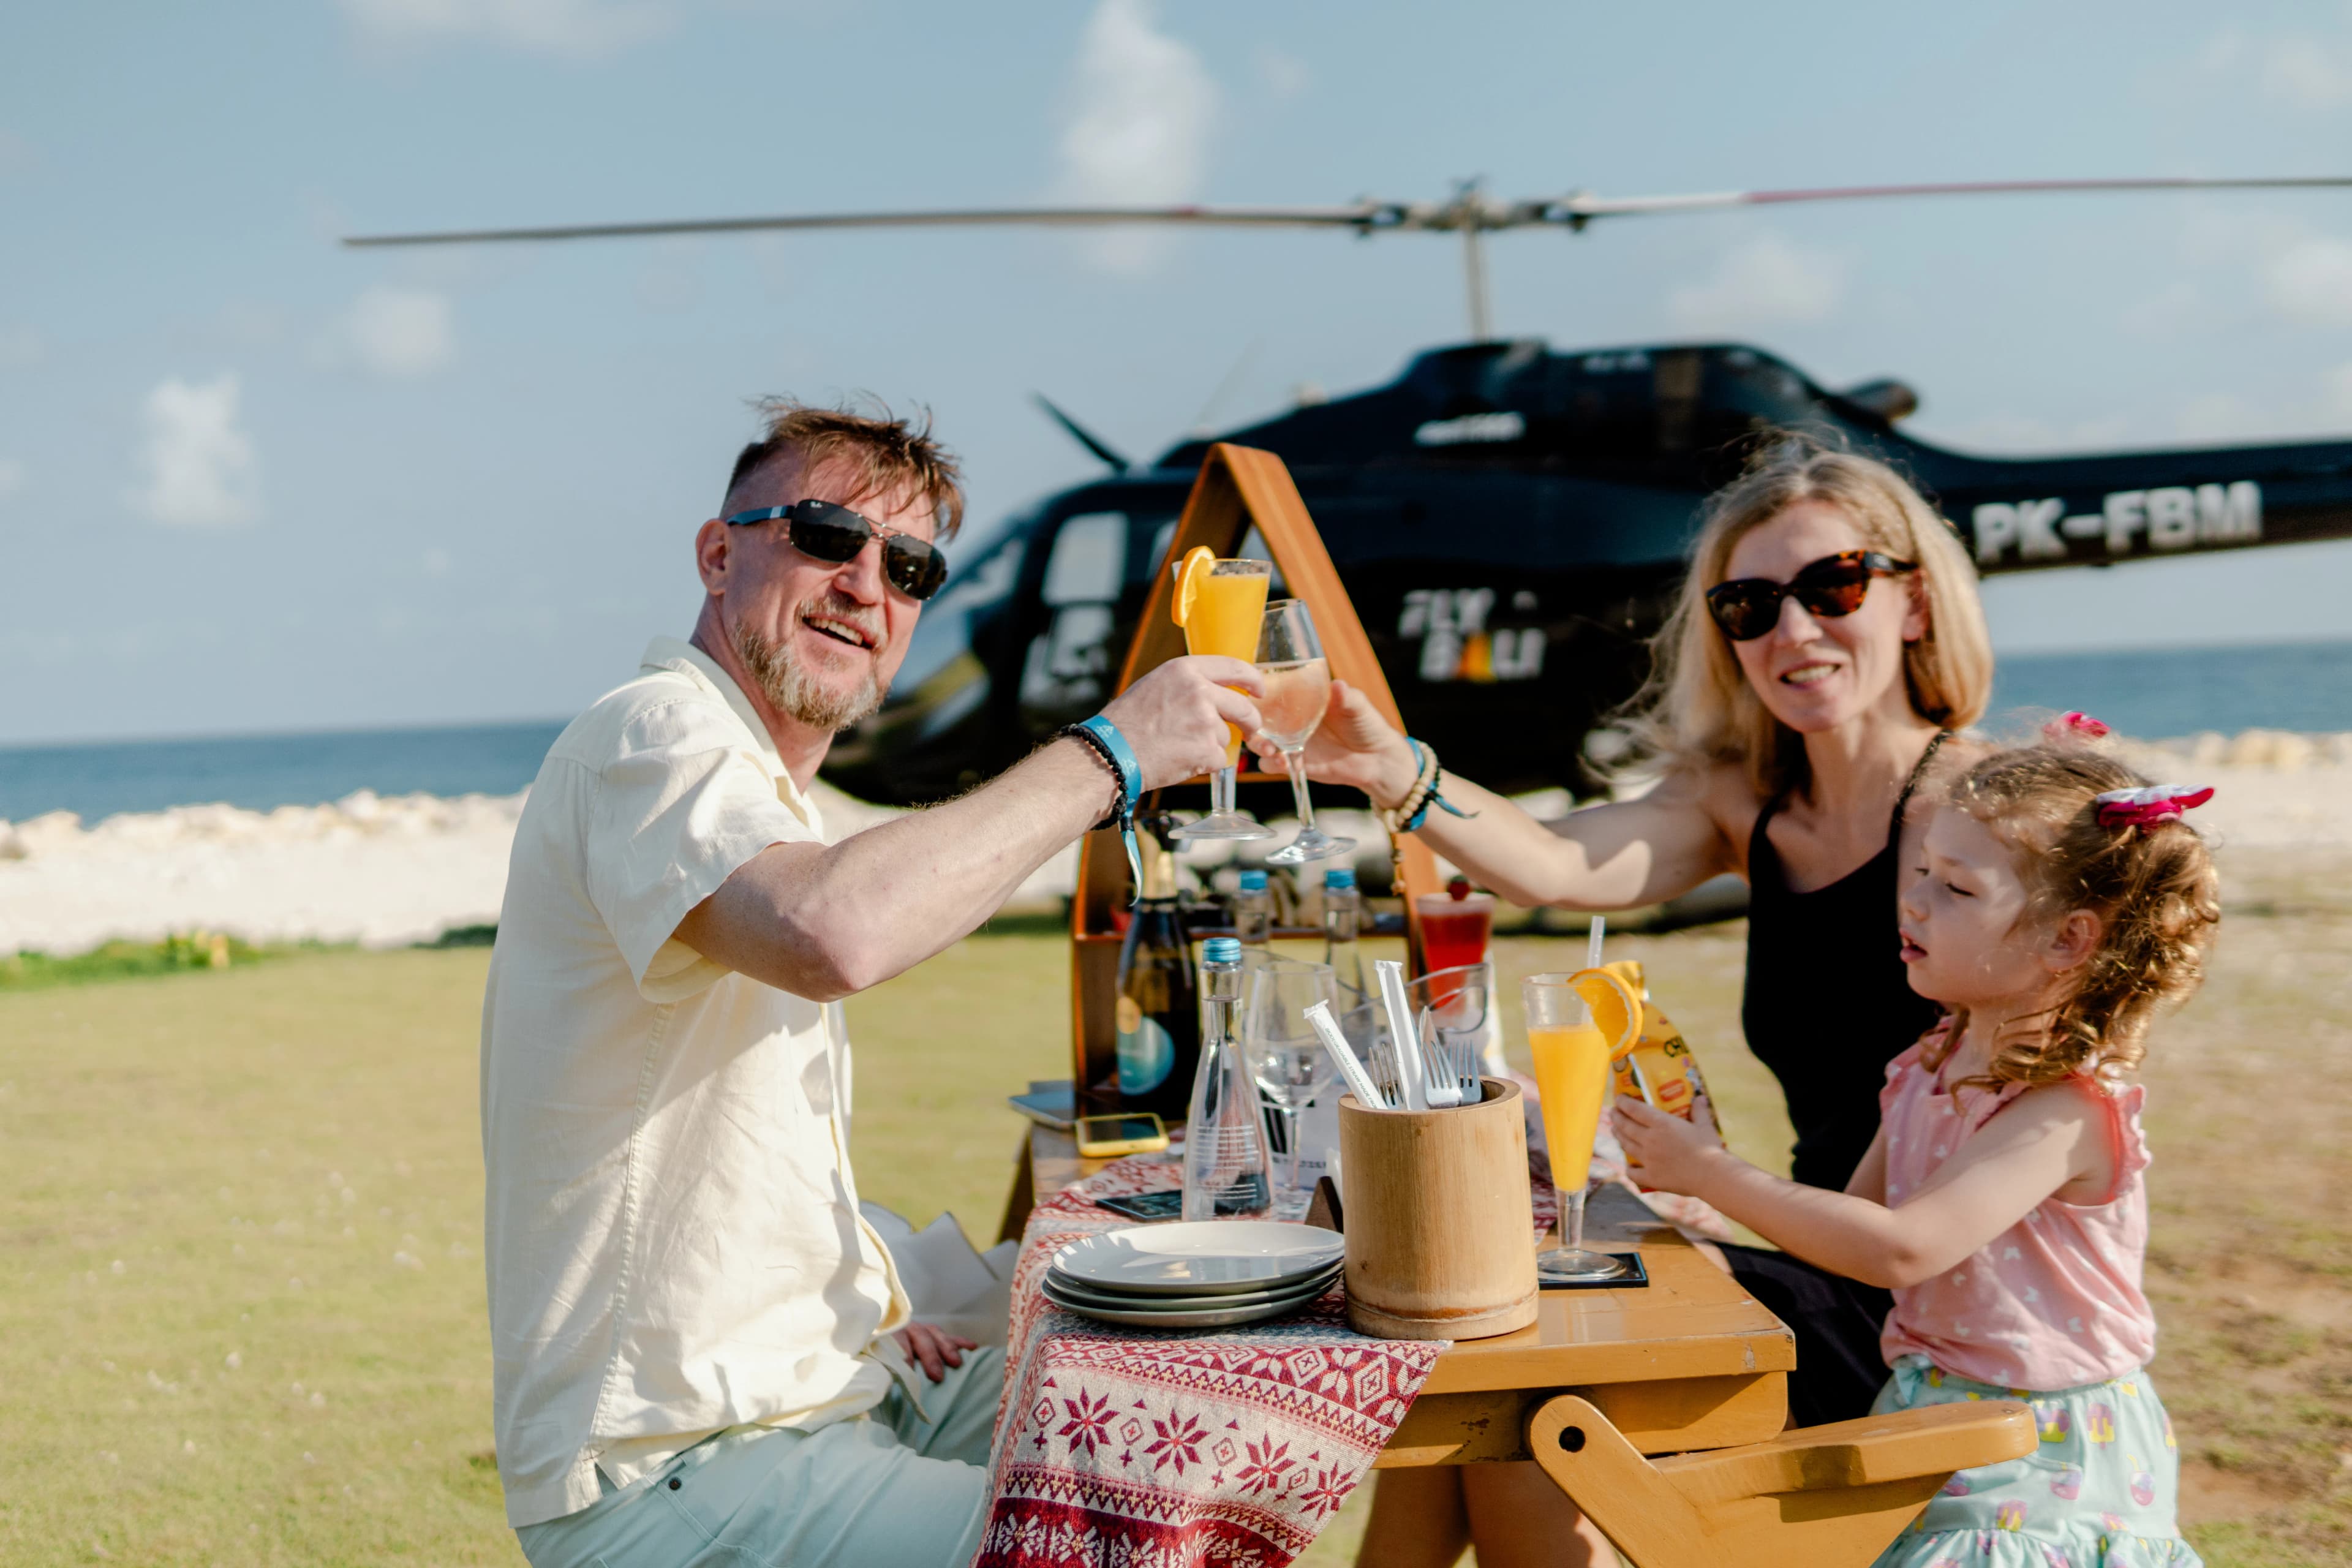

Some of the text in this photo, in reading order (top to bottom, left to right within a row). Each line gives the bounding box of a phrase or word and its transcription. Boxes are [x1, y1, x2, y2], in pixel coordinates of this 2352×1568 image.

[1972, 479, 2263, 562] PK-FBM
[1398, 588, 1494, 638] FLY
[1349, 1065, 1362, 1084] STRAW
